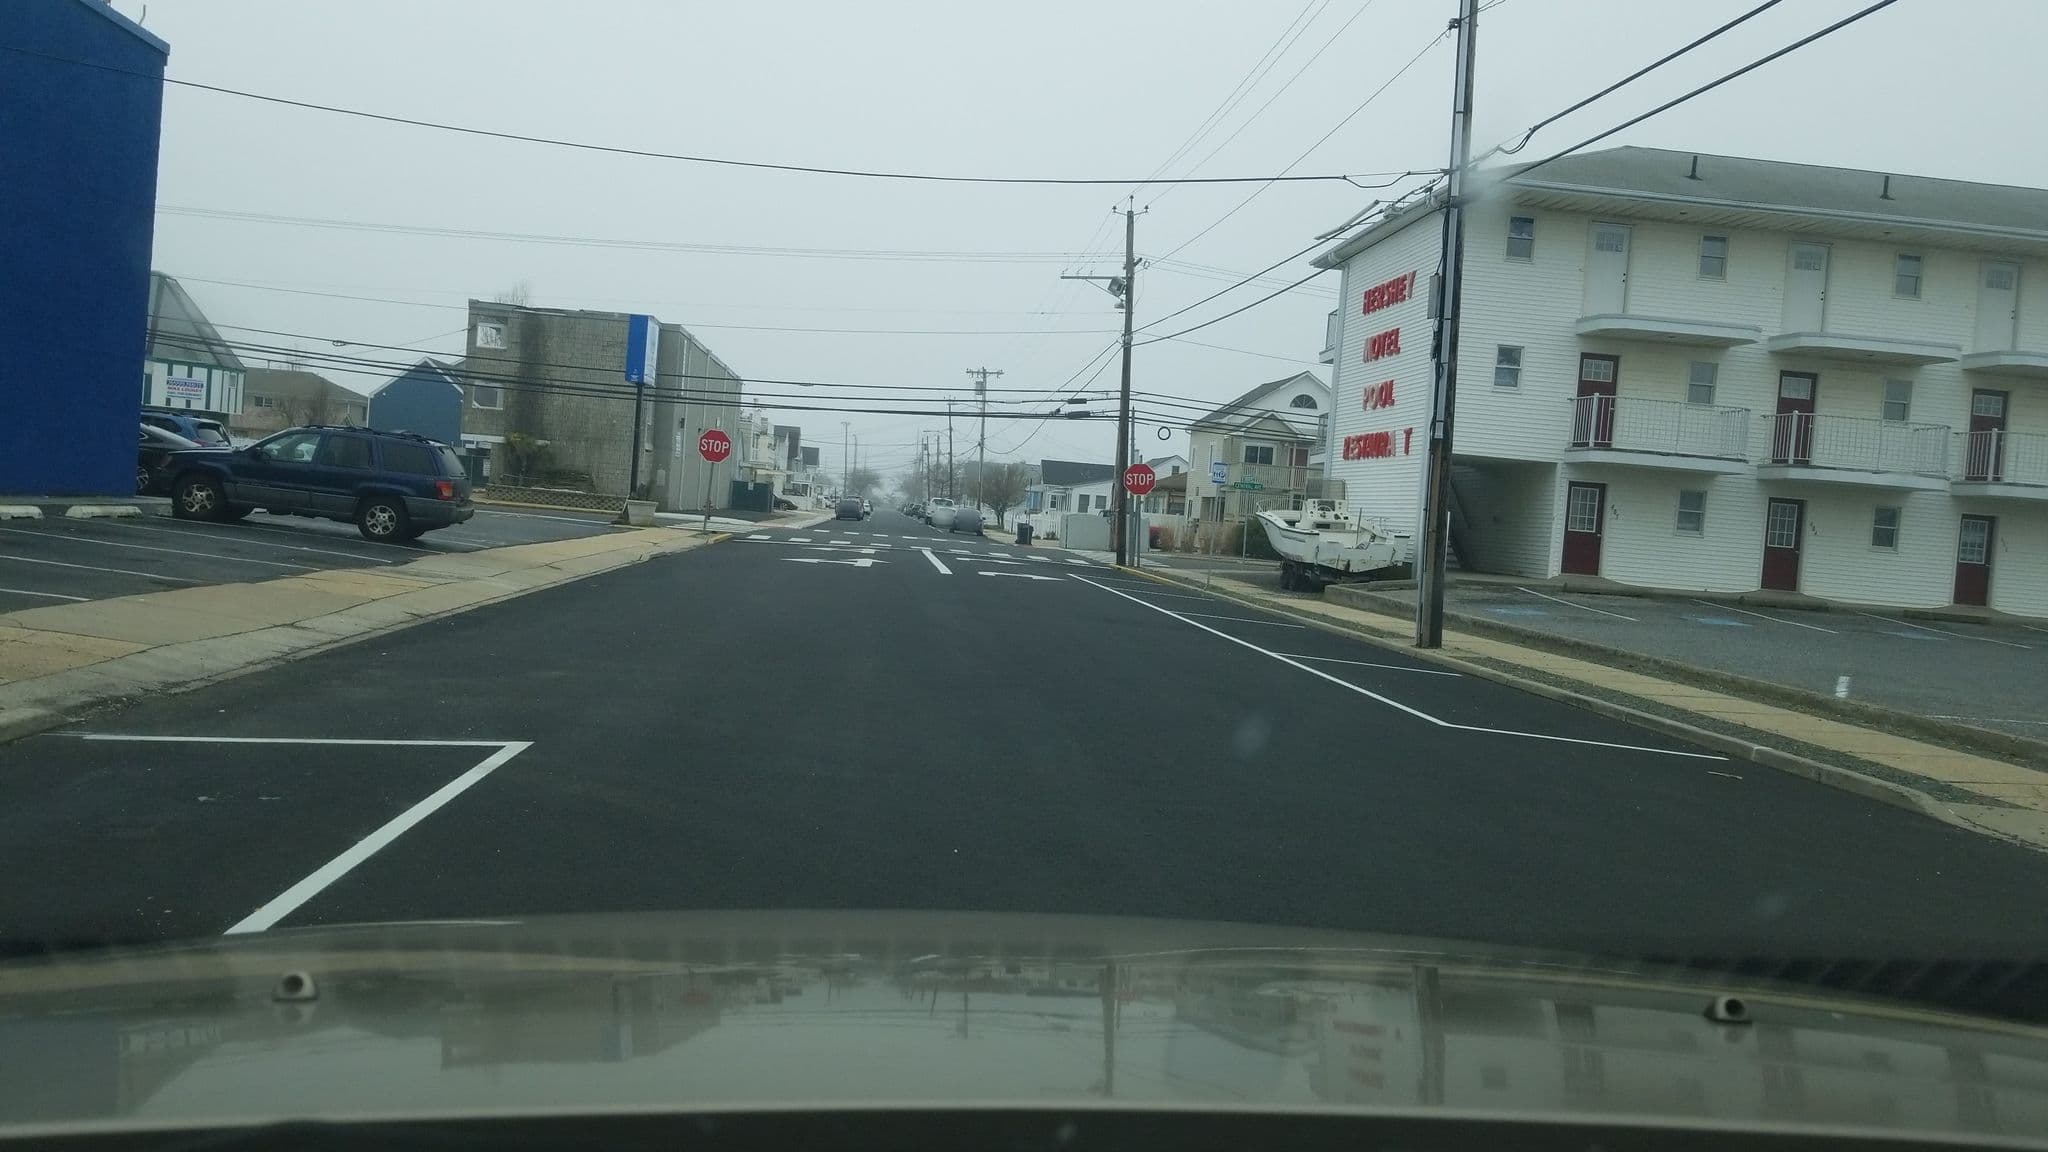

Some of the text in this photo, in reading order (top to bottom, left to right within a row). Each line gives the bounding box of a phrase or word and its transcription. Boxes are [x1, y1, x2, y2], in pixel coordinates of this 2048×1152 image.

[1362, 270, 1417, 315] HERSHEY
[1363, 327, 1401, 363] MOTEL
[1363, 379, 1394, 411] POOL
[701, 438, 730, 453] STOP
[1126, 473, 1154, 486] STOP
